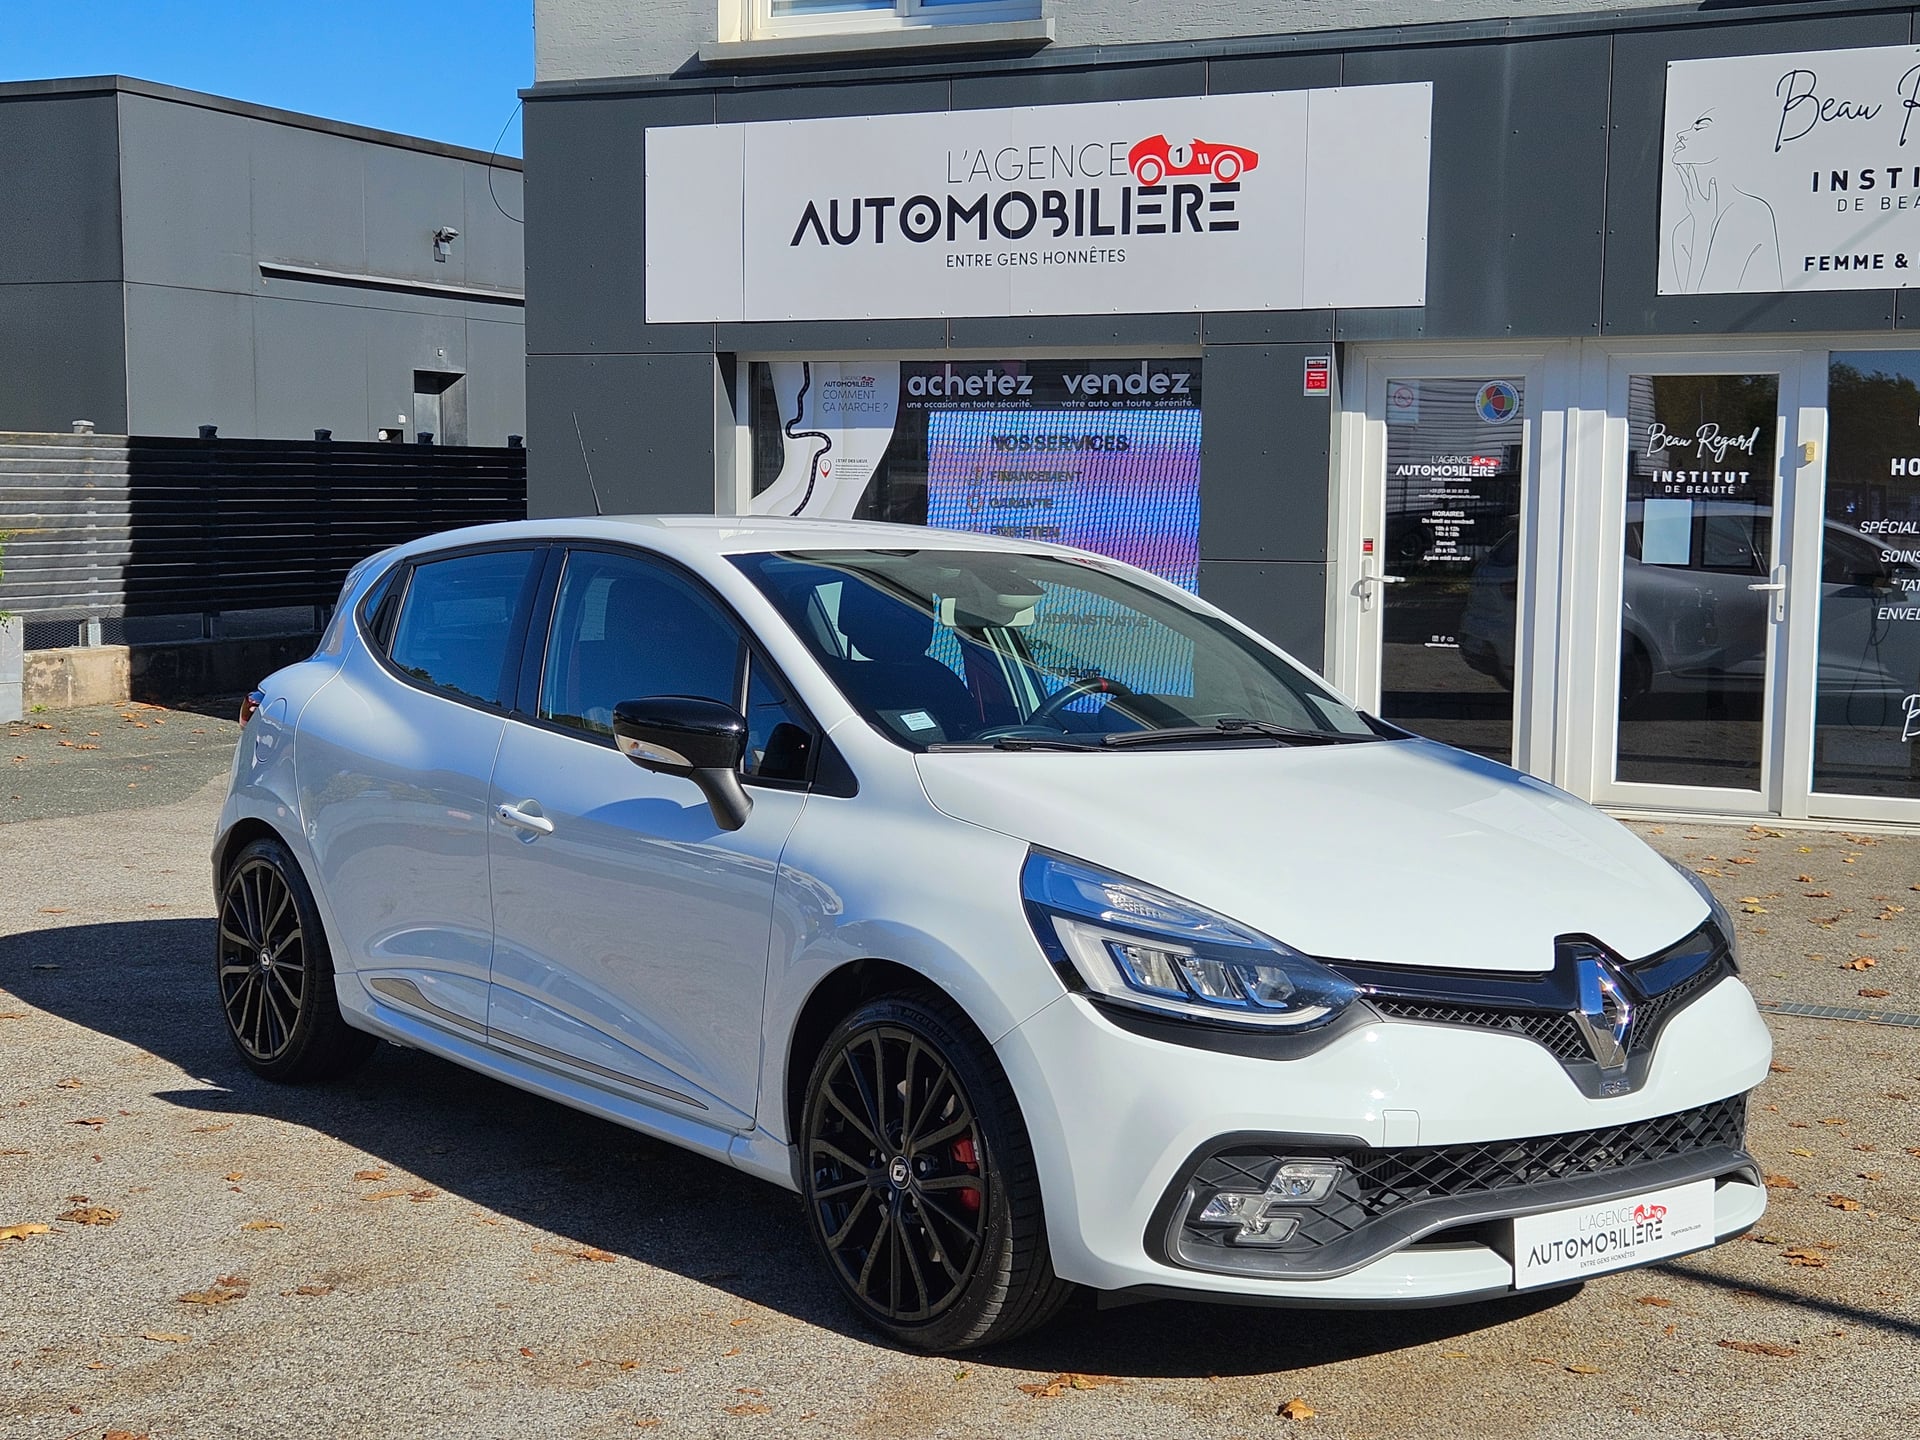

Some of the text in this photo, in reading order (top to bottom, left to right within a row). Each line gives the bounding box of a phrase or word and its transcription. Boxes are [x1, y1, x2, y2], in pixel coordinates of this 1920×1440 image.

[1774, 69, 1882, 153] Beau
[947, 141, 1128, 184] L'AGENCE
[1837, 197, 1865, 213] DE
[946, 246, 1127, 268] ENTRE GENS HONNÊTES
[1804, 253, 1885, 272] FEMME
[1894, 252, 1909, 268] &
[907, 363, 1034, 397] achetez
[1062, 360, 1191, 395] vendez
[823, 389, 877, 400] COMMENT
[822, 402, 889, 414] ÇA MARCHE ?
[924, 399, 958, 408] occasion
[960, 400, 970, 408] en
[973, 400, 995, 408] toute
[998, 398, 1033, 408] sécurité.
[1061, 397, 1195, 408] votre auto en toute sérénité.
[991, 435, 1130, 451] NOS SERVICES
[1646, 422, 1761, 463] Beau Regard
[1431, 456, 1473, 465] L'AGENCE
[991, 470, 1083, 482] FINANCEMENT
[1652, 470, 1750, 483] INSTITUT
[1665, 483, 1736, 494] DE BEAUTÉ
[990, 497, 1054, 509] GARANTIE
[1859, 519, 1920, 534] SPÉCIAL
[1579, 1206, 1634, 1232] L'AGENCE
[1580, 1259, 1596, 1268] ENTRE
[1596, 1256, 1611, 1265] GENS
